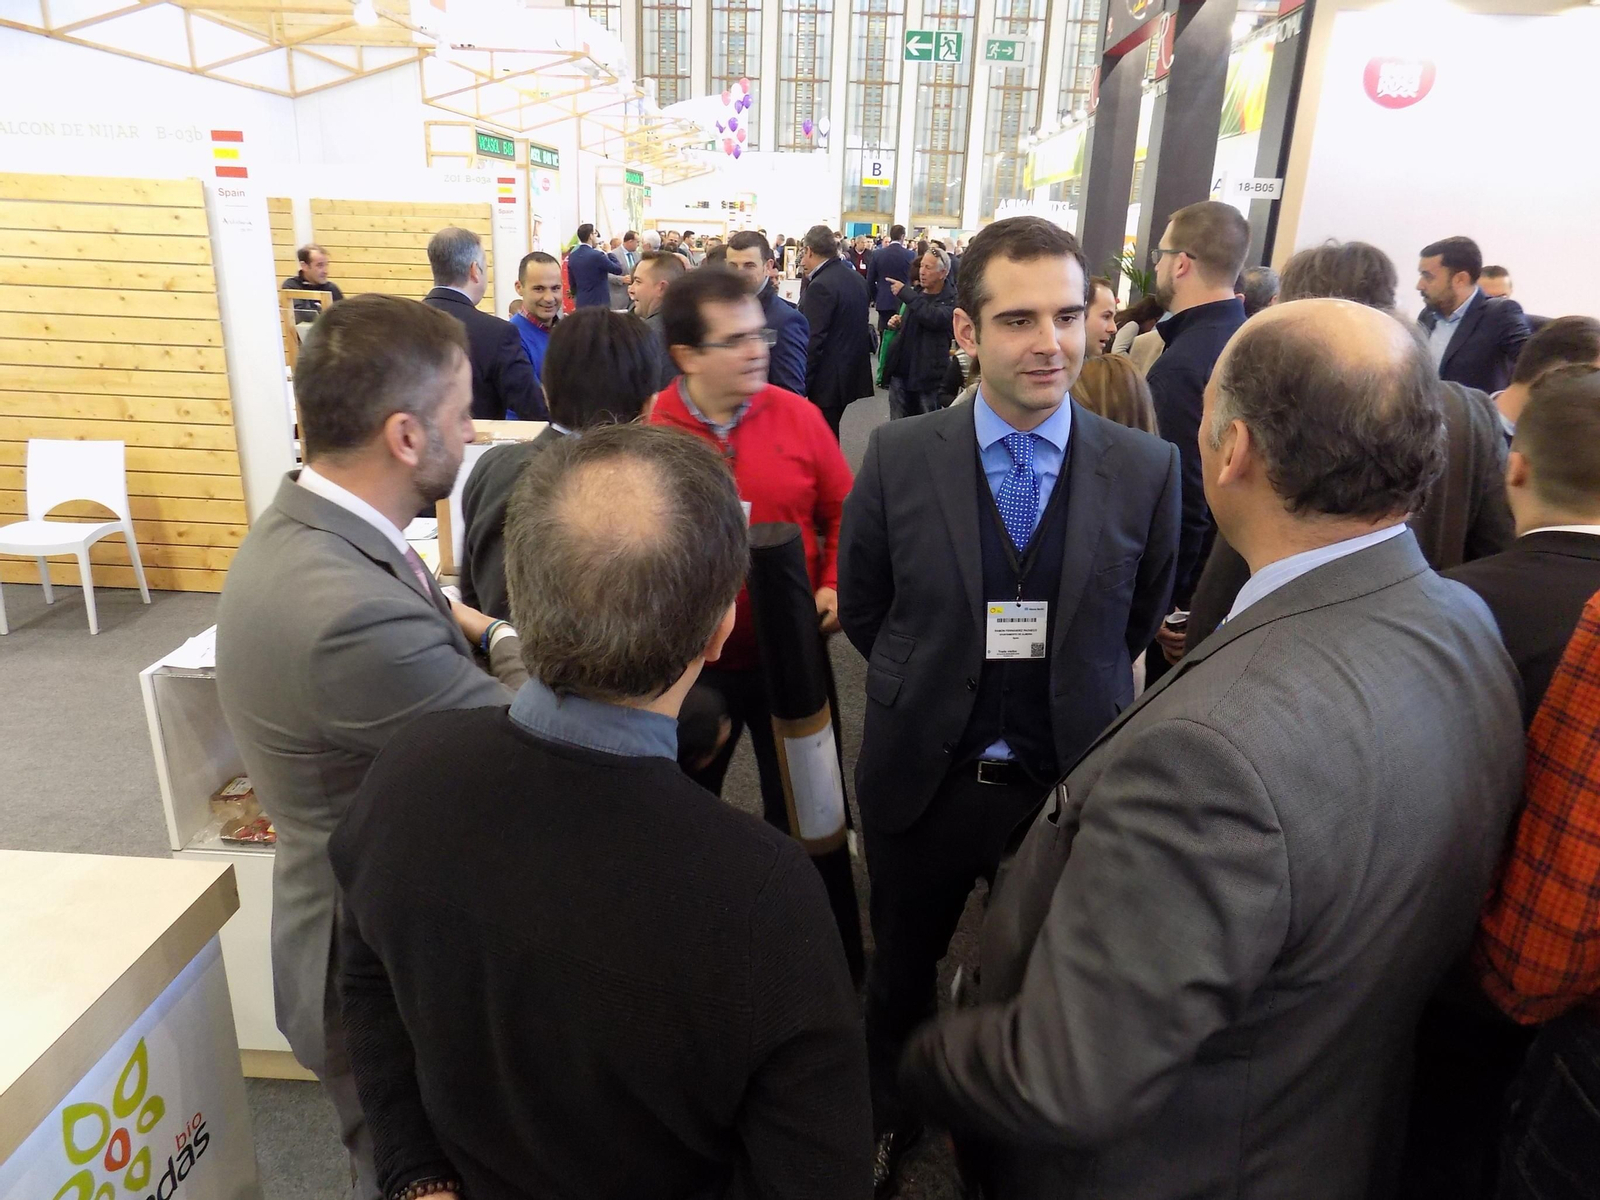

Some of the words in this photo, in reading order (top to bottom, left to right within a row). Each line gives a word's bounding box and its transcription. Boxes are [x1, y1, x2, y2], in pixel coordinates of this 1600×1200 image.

[60, 123, 84, 137] DE
[156, 125, 203, 143] B-03b
[872, 162, 882, 177] B
[218, 187, 246, 198] Spain
[1238, 182, 1275, 193] 18-B05
[175, 1112, 202, 1151] bio
